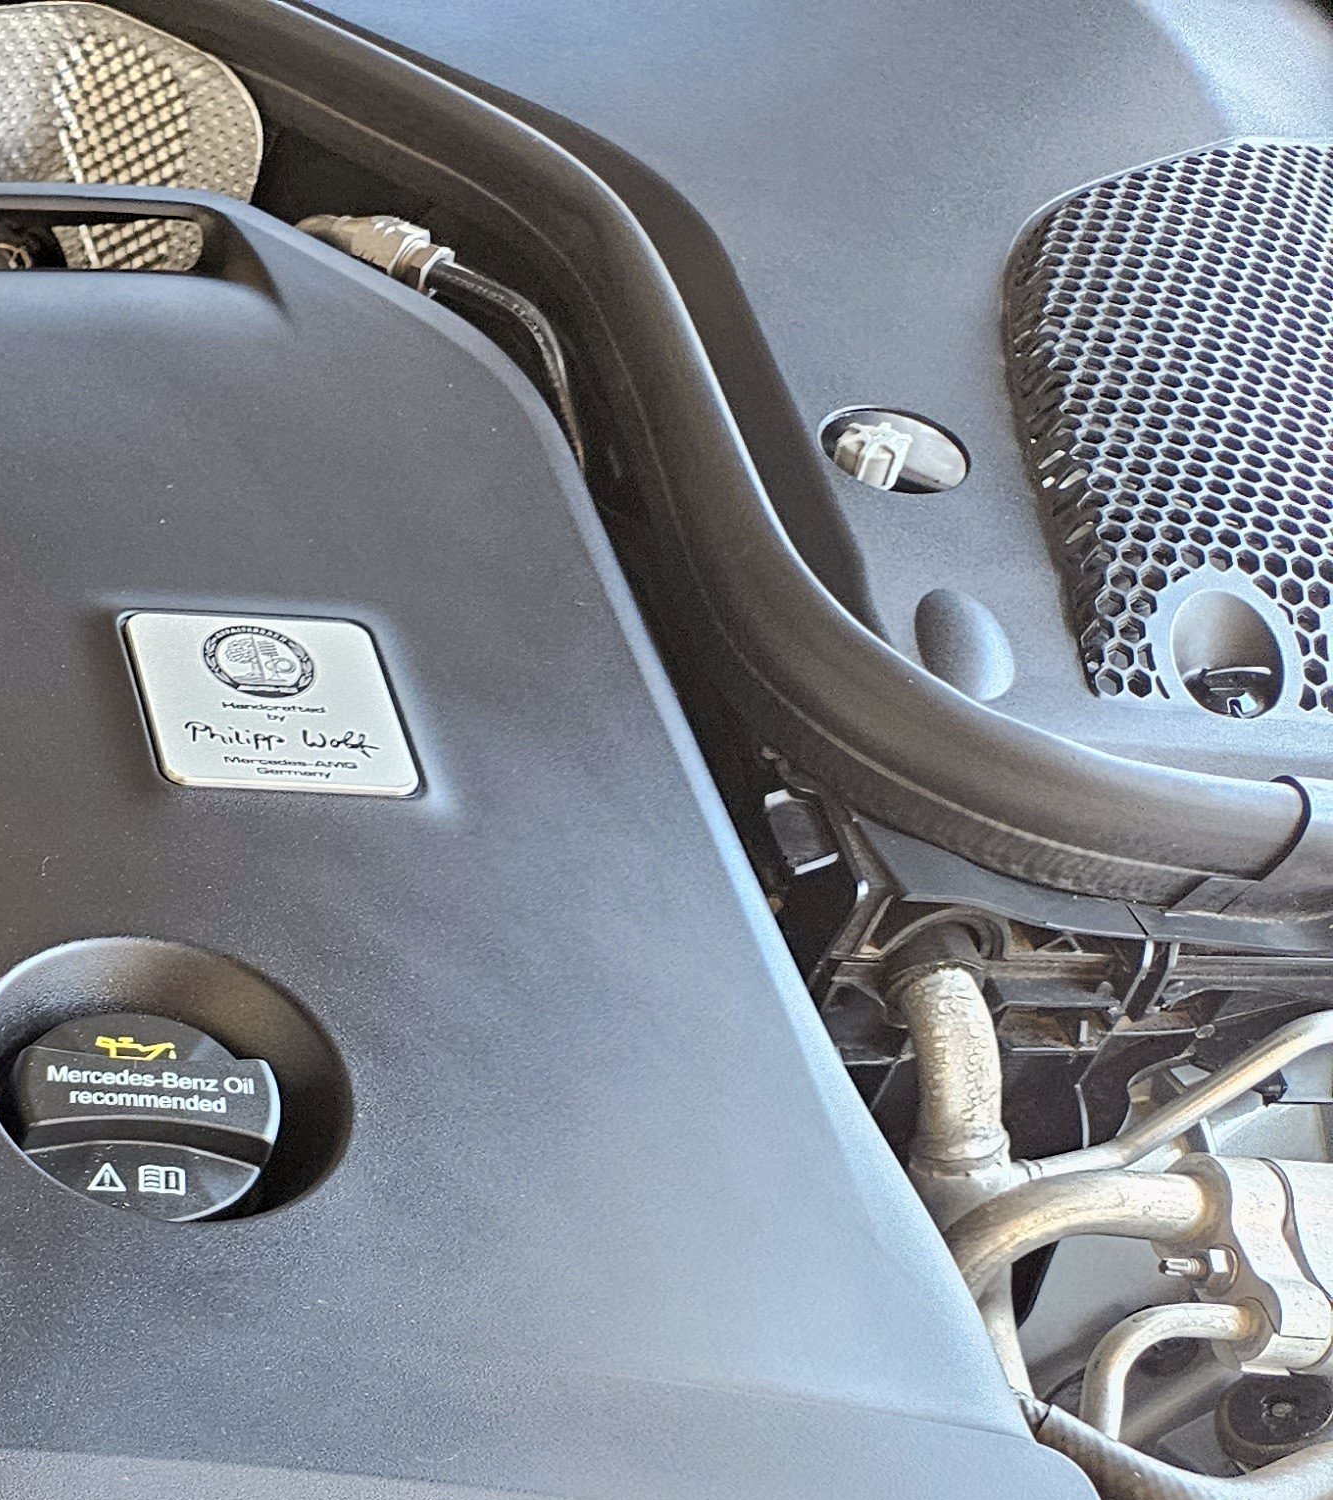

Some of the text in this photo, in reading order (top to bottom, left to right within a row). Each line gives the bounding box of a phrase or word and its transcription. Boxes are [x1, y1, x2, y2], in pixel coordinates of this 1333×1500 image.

[221, 700, 327, 714] Handcrafted
[266, 713, 286, 722] by
[184, 720, 286, 751] Philipp
[223, 755, 359, 769] Mercedes-AMG
[256, 767, 331, 779] Germany
[45, 1064, 255, 1095] Mercedes-Benz Oil
[68, 1089, 227, 1114] recommended
